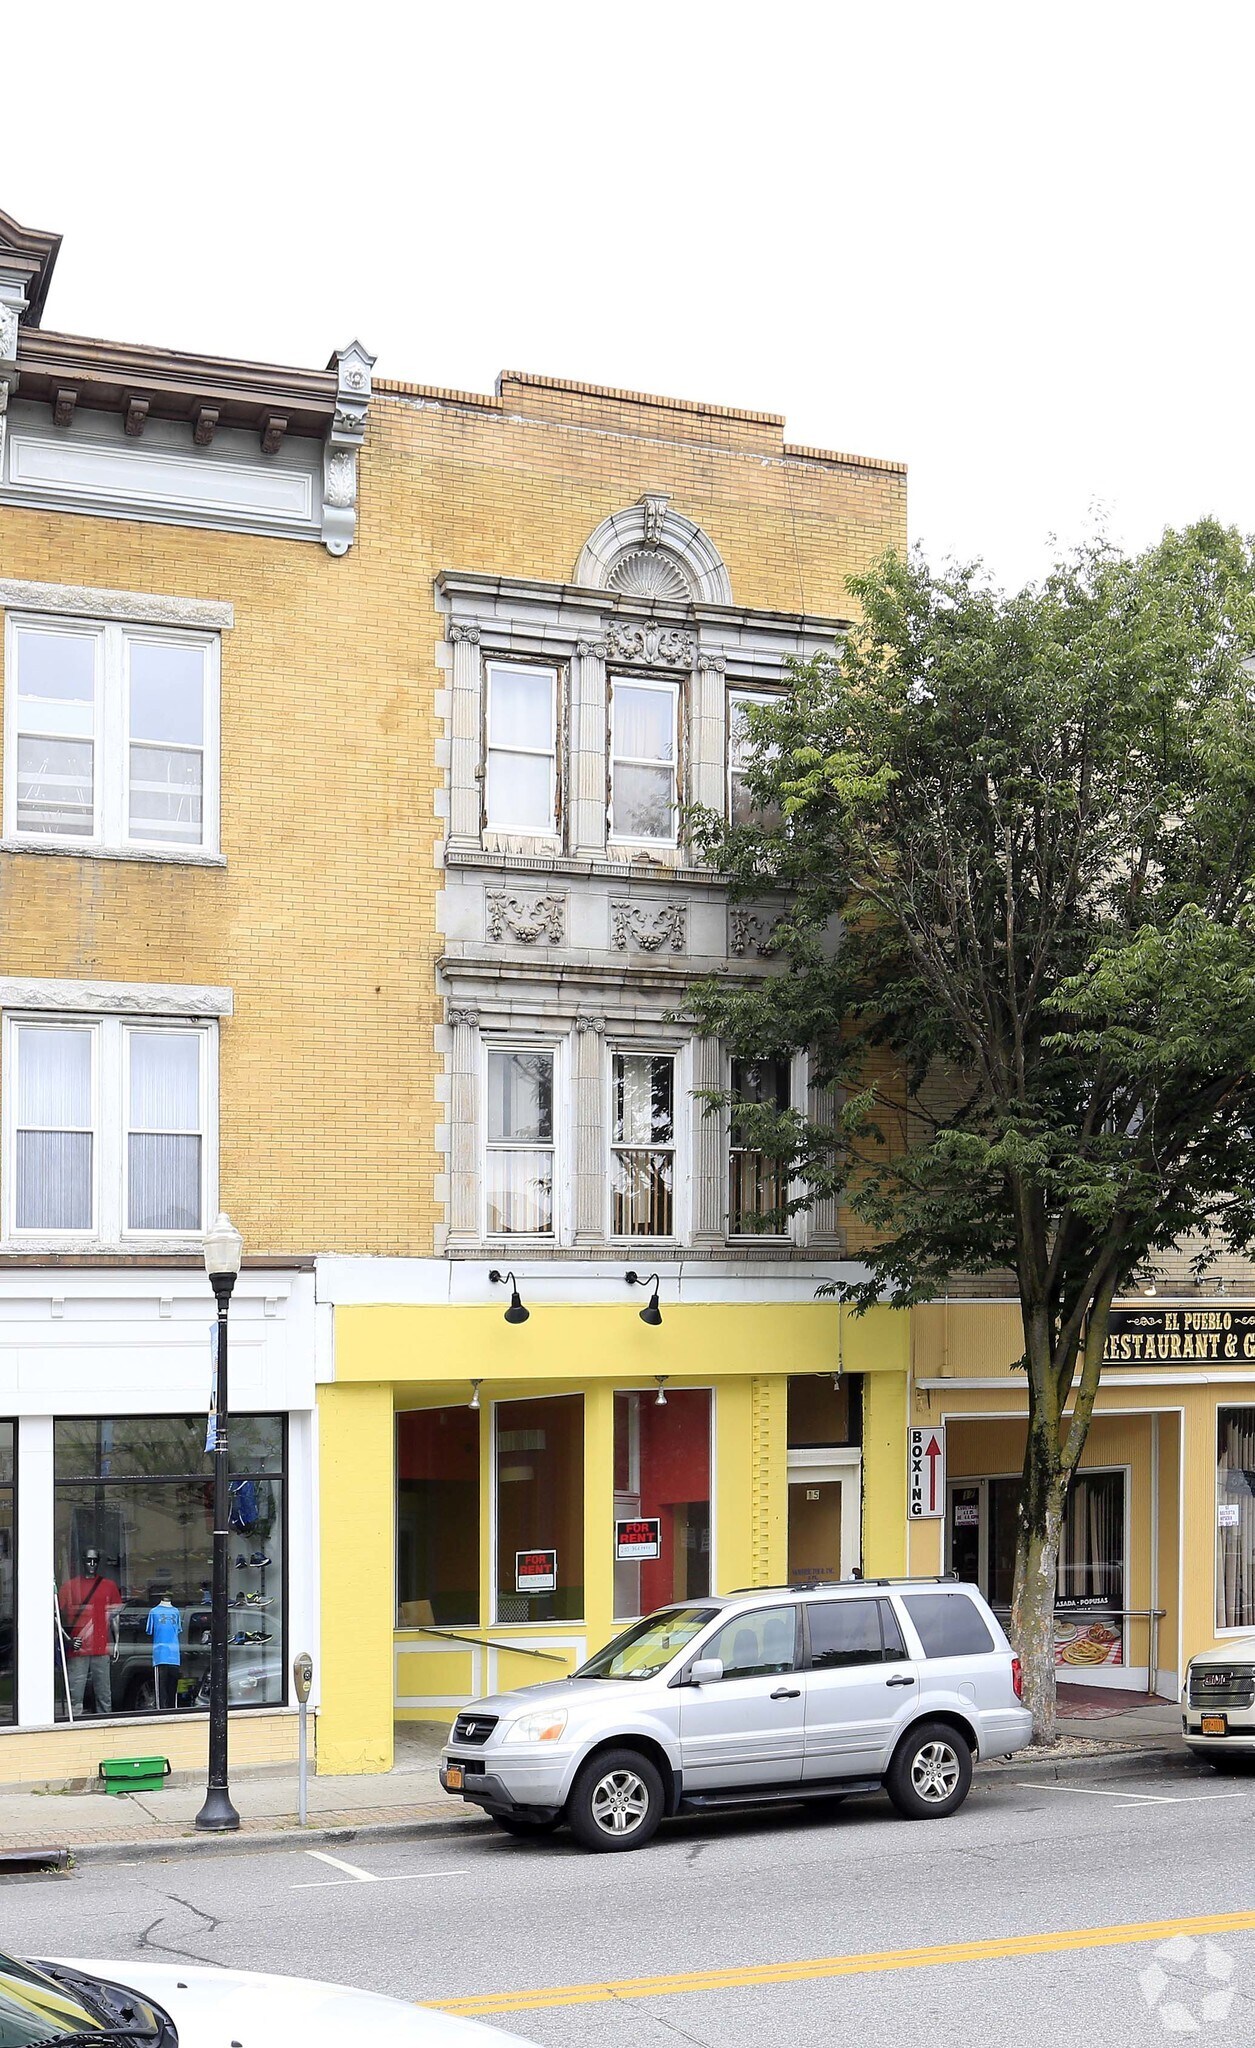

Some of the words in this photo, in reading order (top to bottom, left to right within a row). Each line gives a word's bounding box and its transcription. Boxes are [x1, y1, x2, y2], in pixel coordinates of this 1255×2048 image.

[1164, 1312, 1179, 1330] EL
[1184, 1311, 1232, 1331] PUEBLO
[1224, 1333, 1238, 1358] &
[912, 1431, 922, 1515] BOXING
[626, 1523, 649, 1533] FOR
[620, 1533, 655, 1543] RENT
[525, 1555, 546, 1564] FOR
[519, 1564, 552, 1574] RENT
